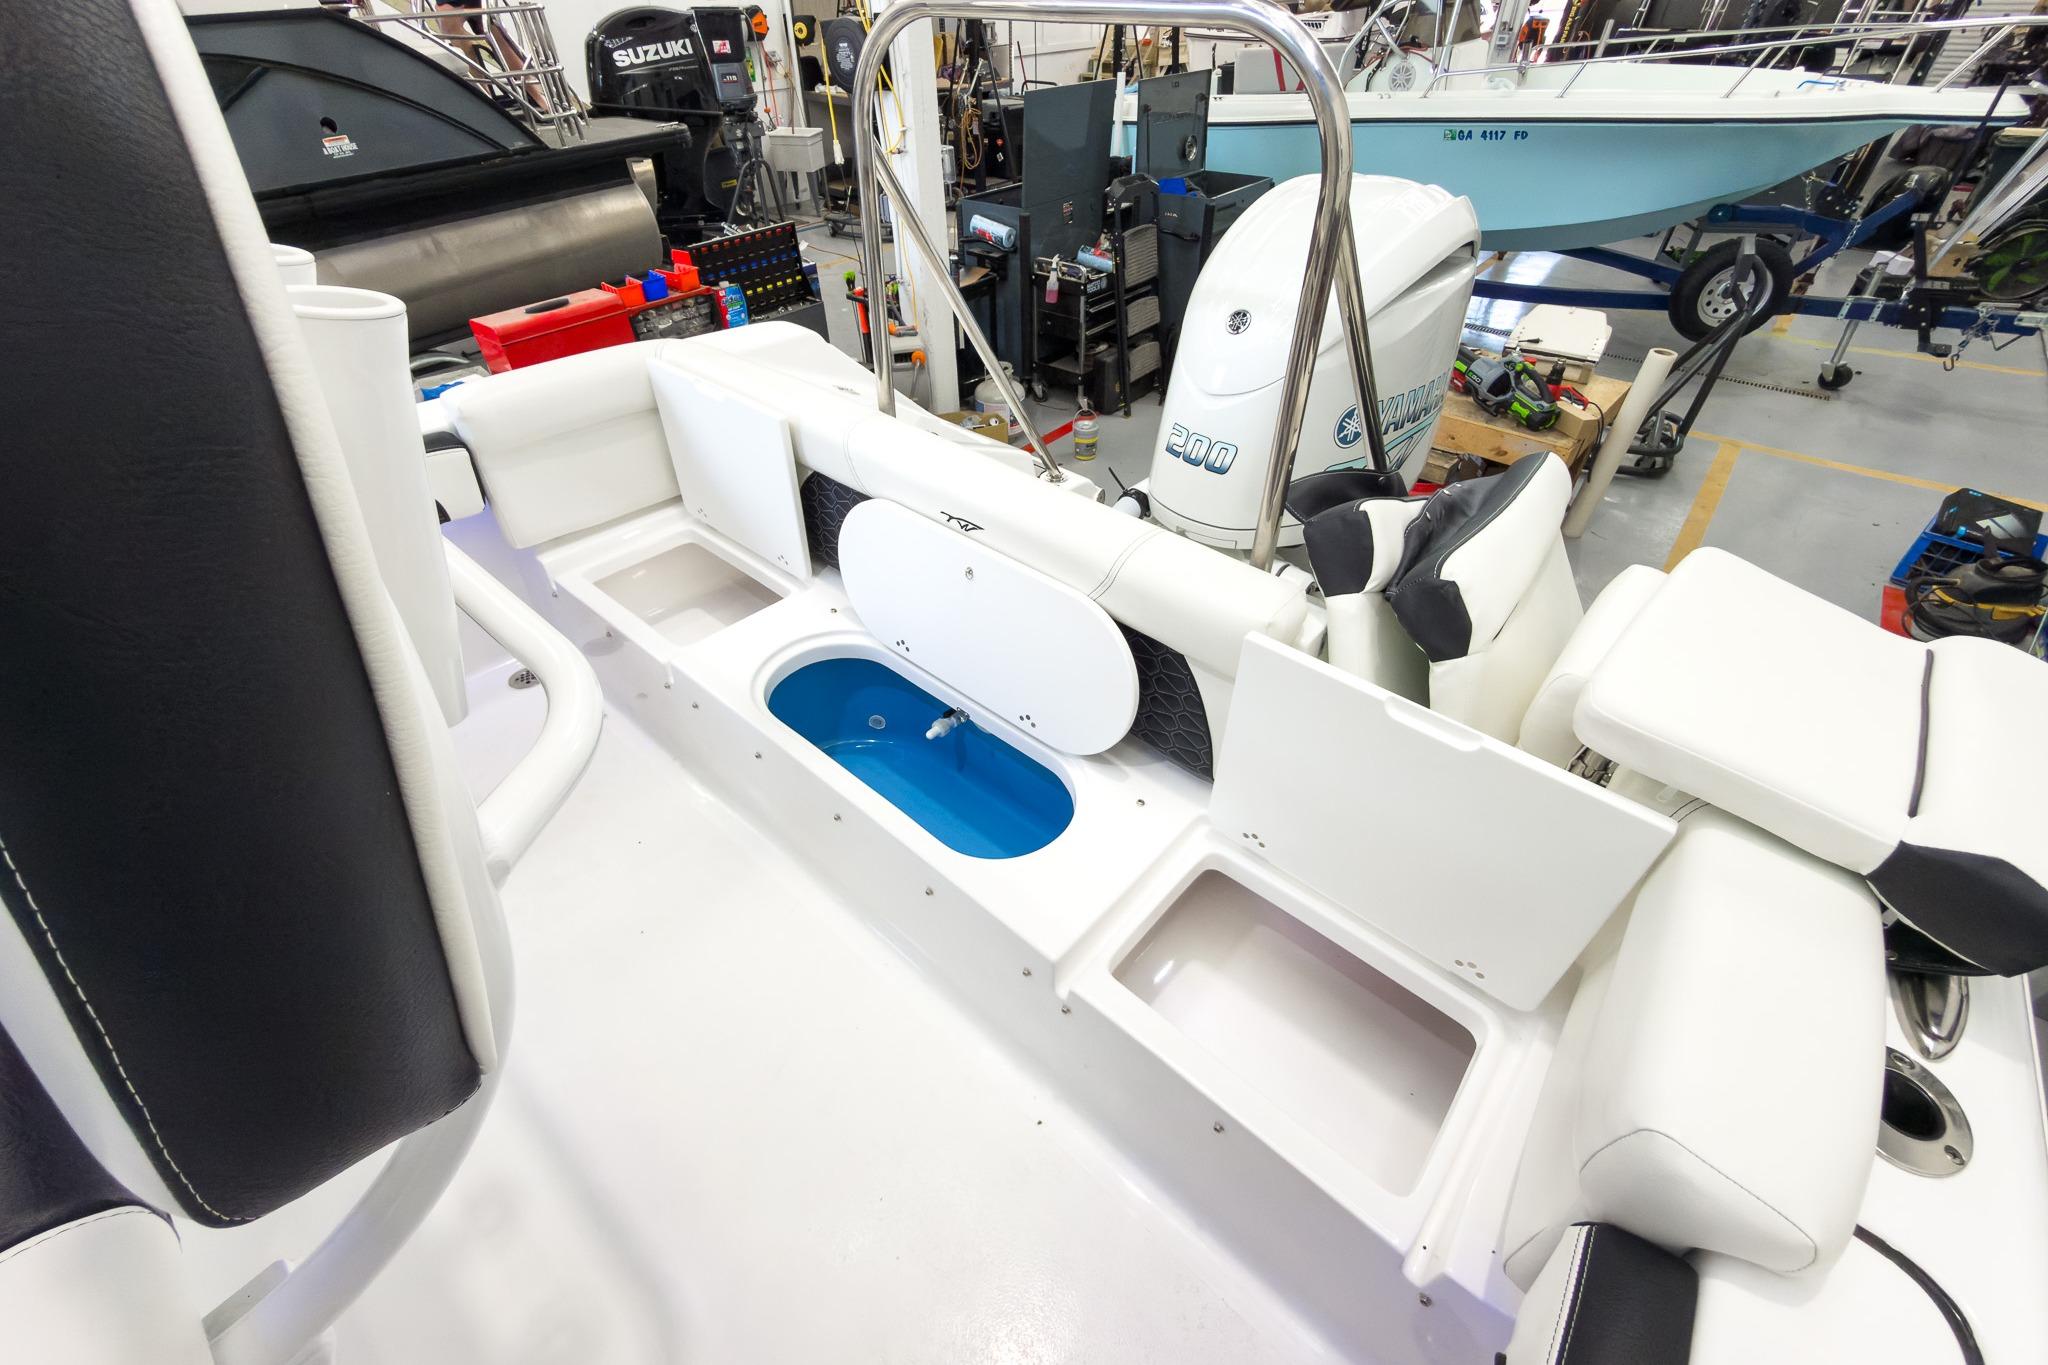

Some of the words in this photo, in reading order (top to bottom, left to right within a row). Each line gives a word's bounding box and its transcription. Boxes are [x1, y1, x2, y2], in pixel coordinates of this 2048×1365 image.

[612, 38, 694, 67] SUZUKI
[1458, 129, 1473, 141] GA
[1480, 130, 1506, 141] 4117
[1514, 130, 1529, 140] FD
[1165, 422, 1238, 475] 200
